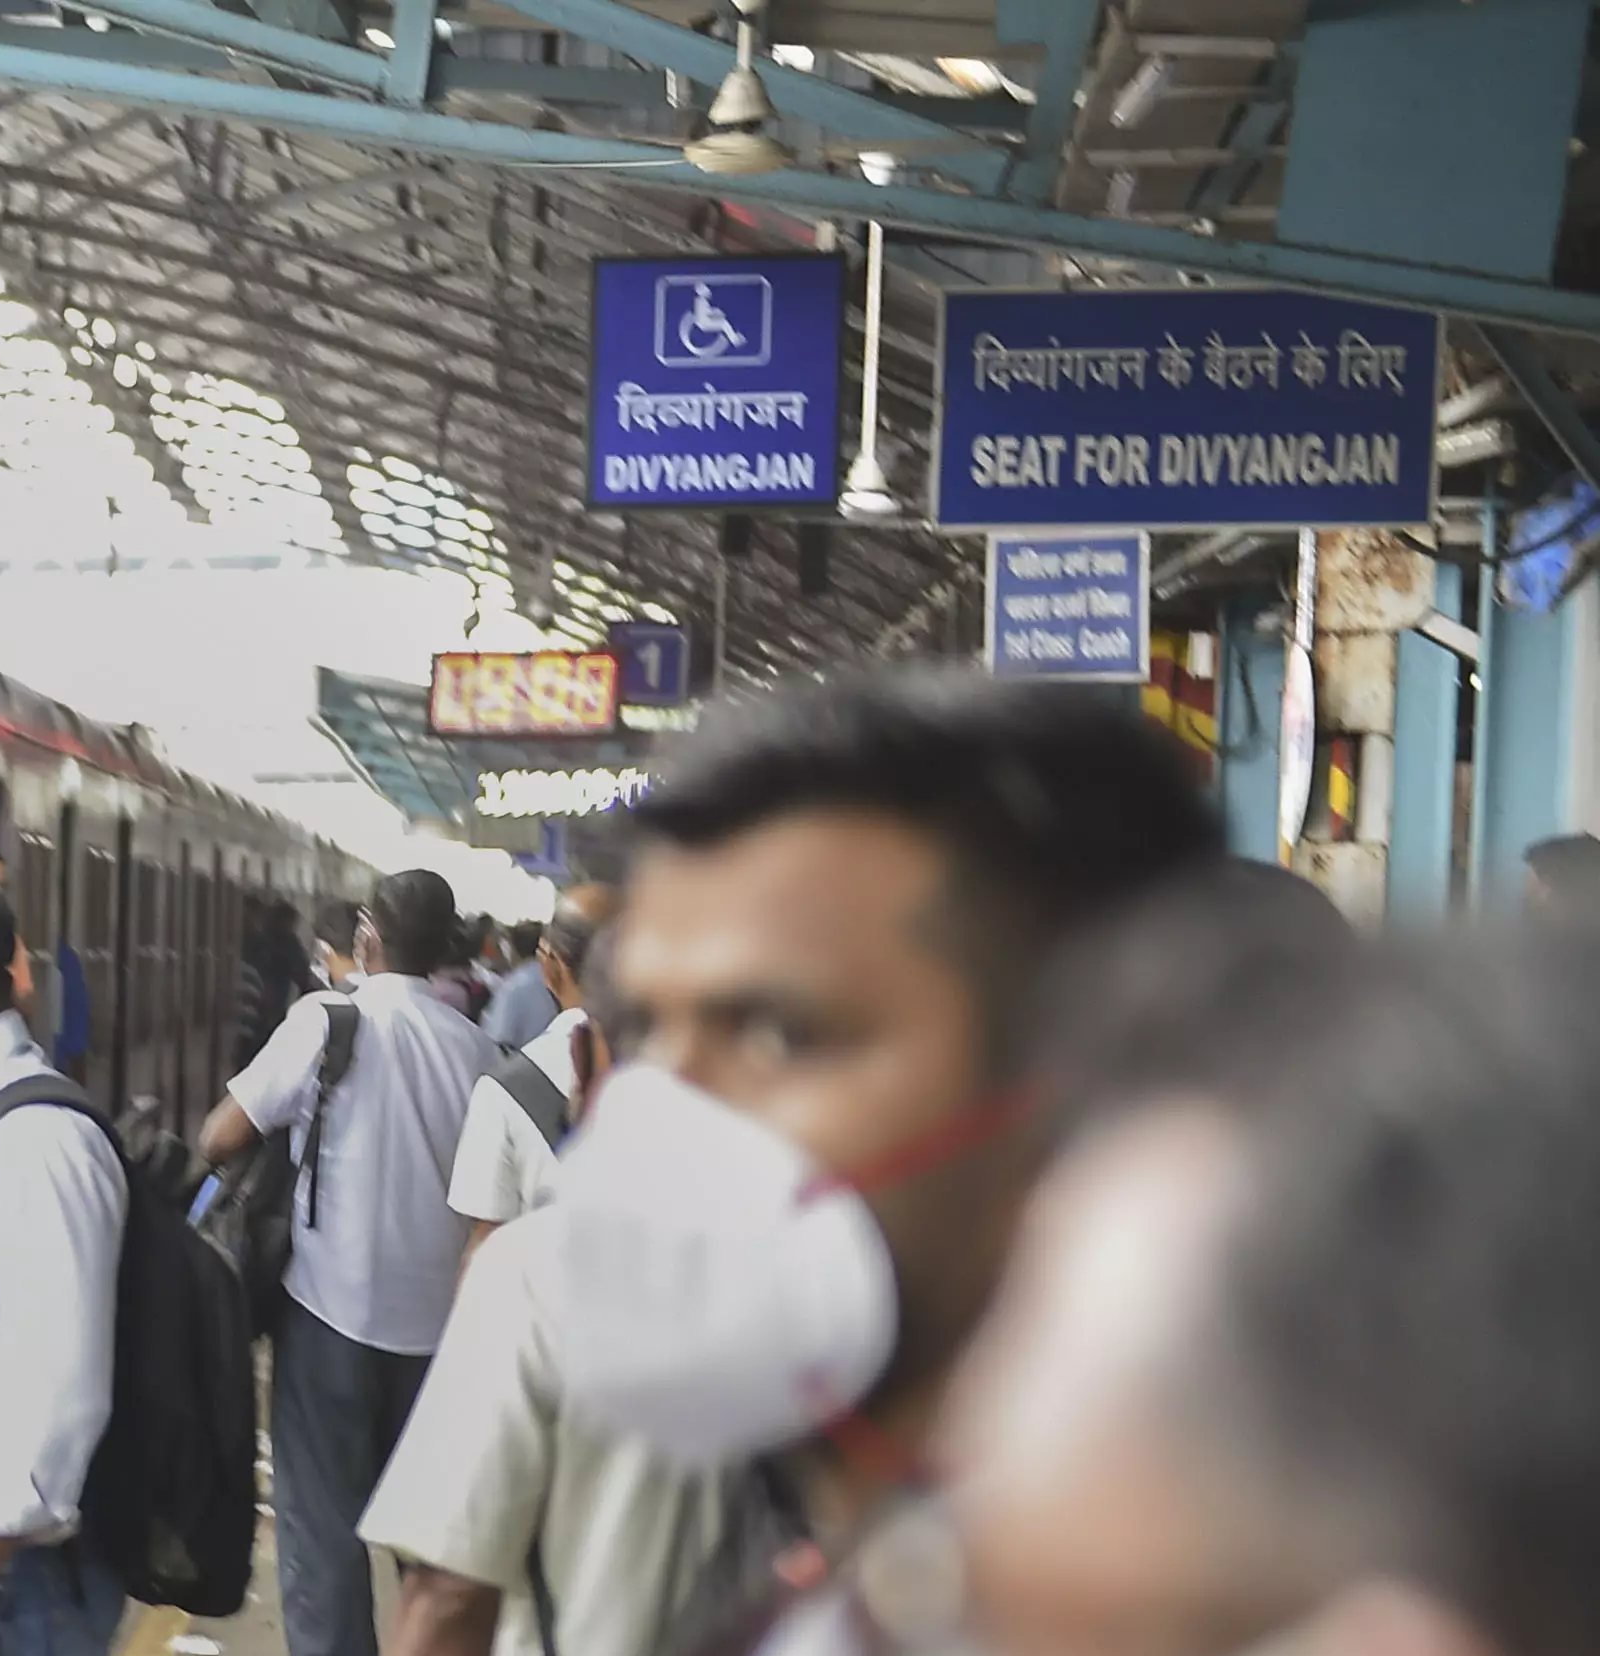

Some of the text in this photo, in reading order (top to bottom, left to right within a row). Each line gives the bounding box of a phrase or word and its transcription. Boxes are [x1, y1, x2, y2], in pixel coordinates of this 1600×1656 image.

[1157, 331, 1195, 390] के
[1202, 330, 1283, 390] बैठने
[1290, 330, 1329, 390] के
[1336, 329, 1407, 397] लिए
[604, 451, 815, 494] DIVYANGJAN
[969, 431, 1400, 488] SEAT FOR DIVYANGJAN
[636, 640, 661, 690] 1
